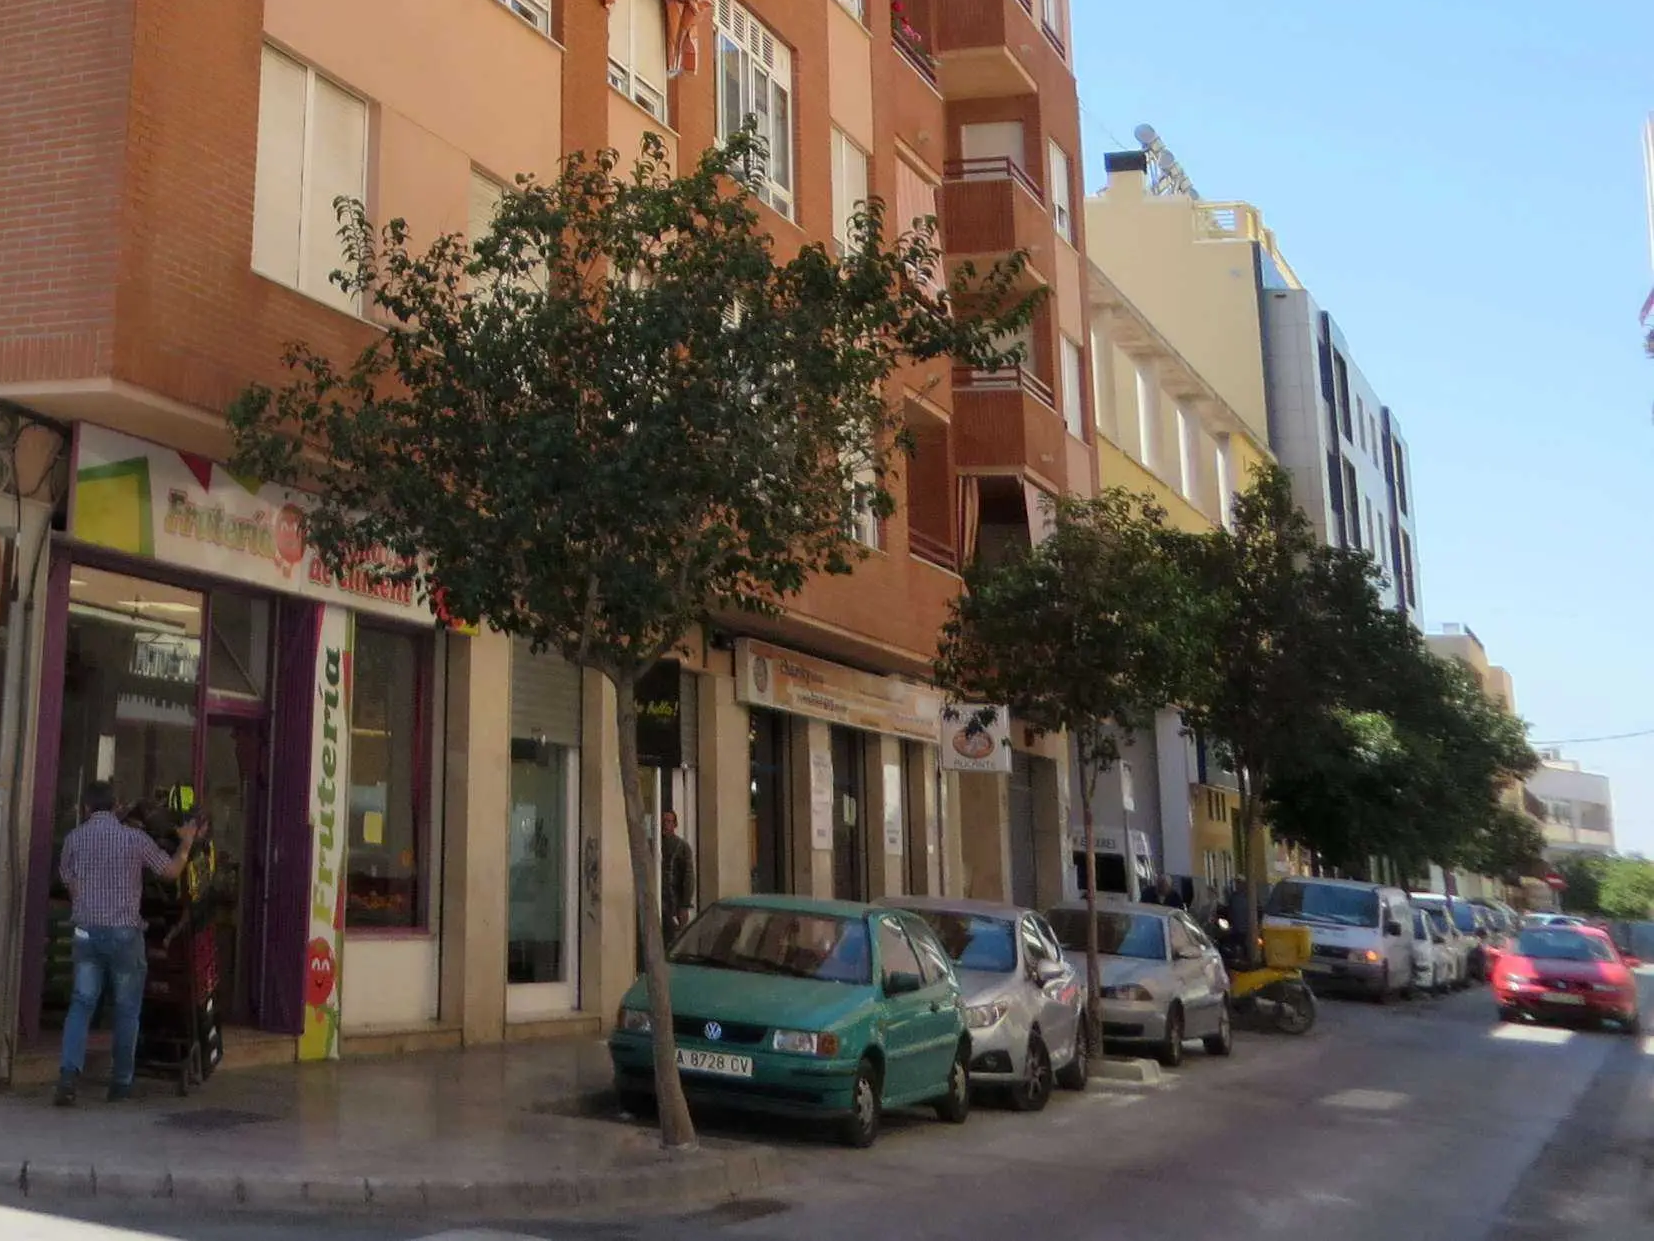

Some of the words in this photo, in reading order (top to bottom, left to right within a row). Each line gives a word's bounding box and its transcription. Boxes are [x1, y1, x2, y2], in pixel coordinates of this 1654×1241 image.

[310, 645, 342, 926] Frutería
[676, 1049, 685, 1066] A
[730, 1055, 749, 1073] CV
